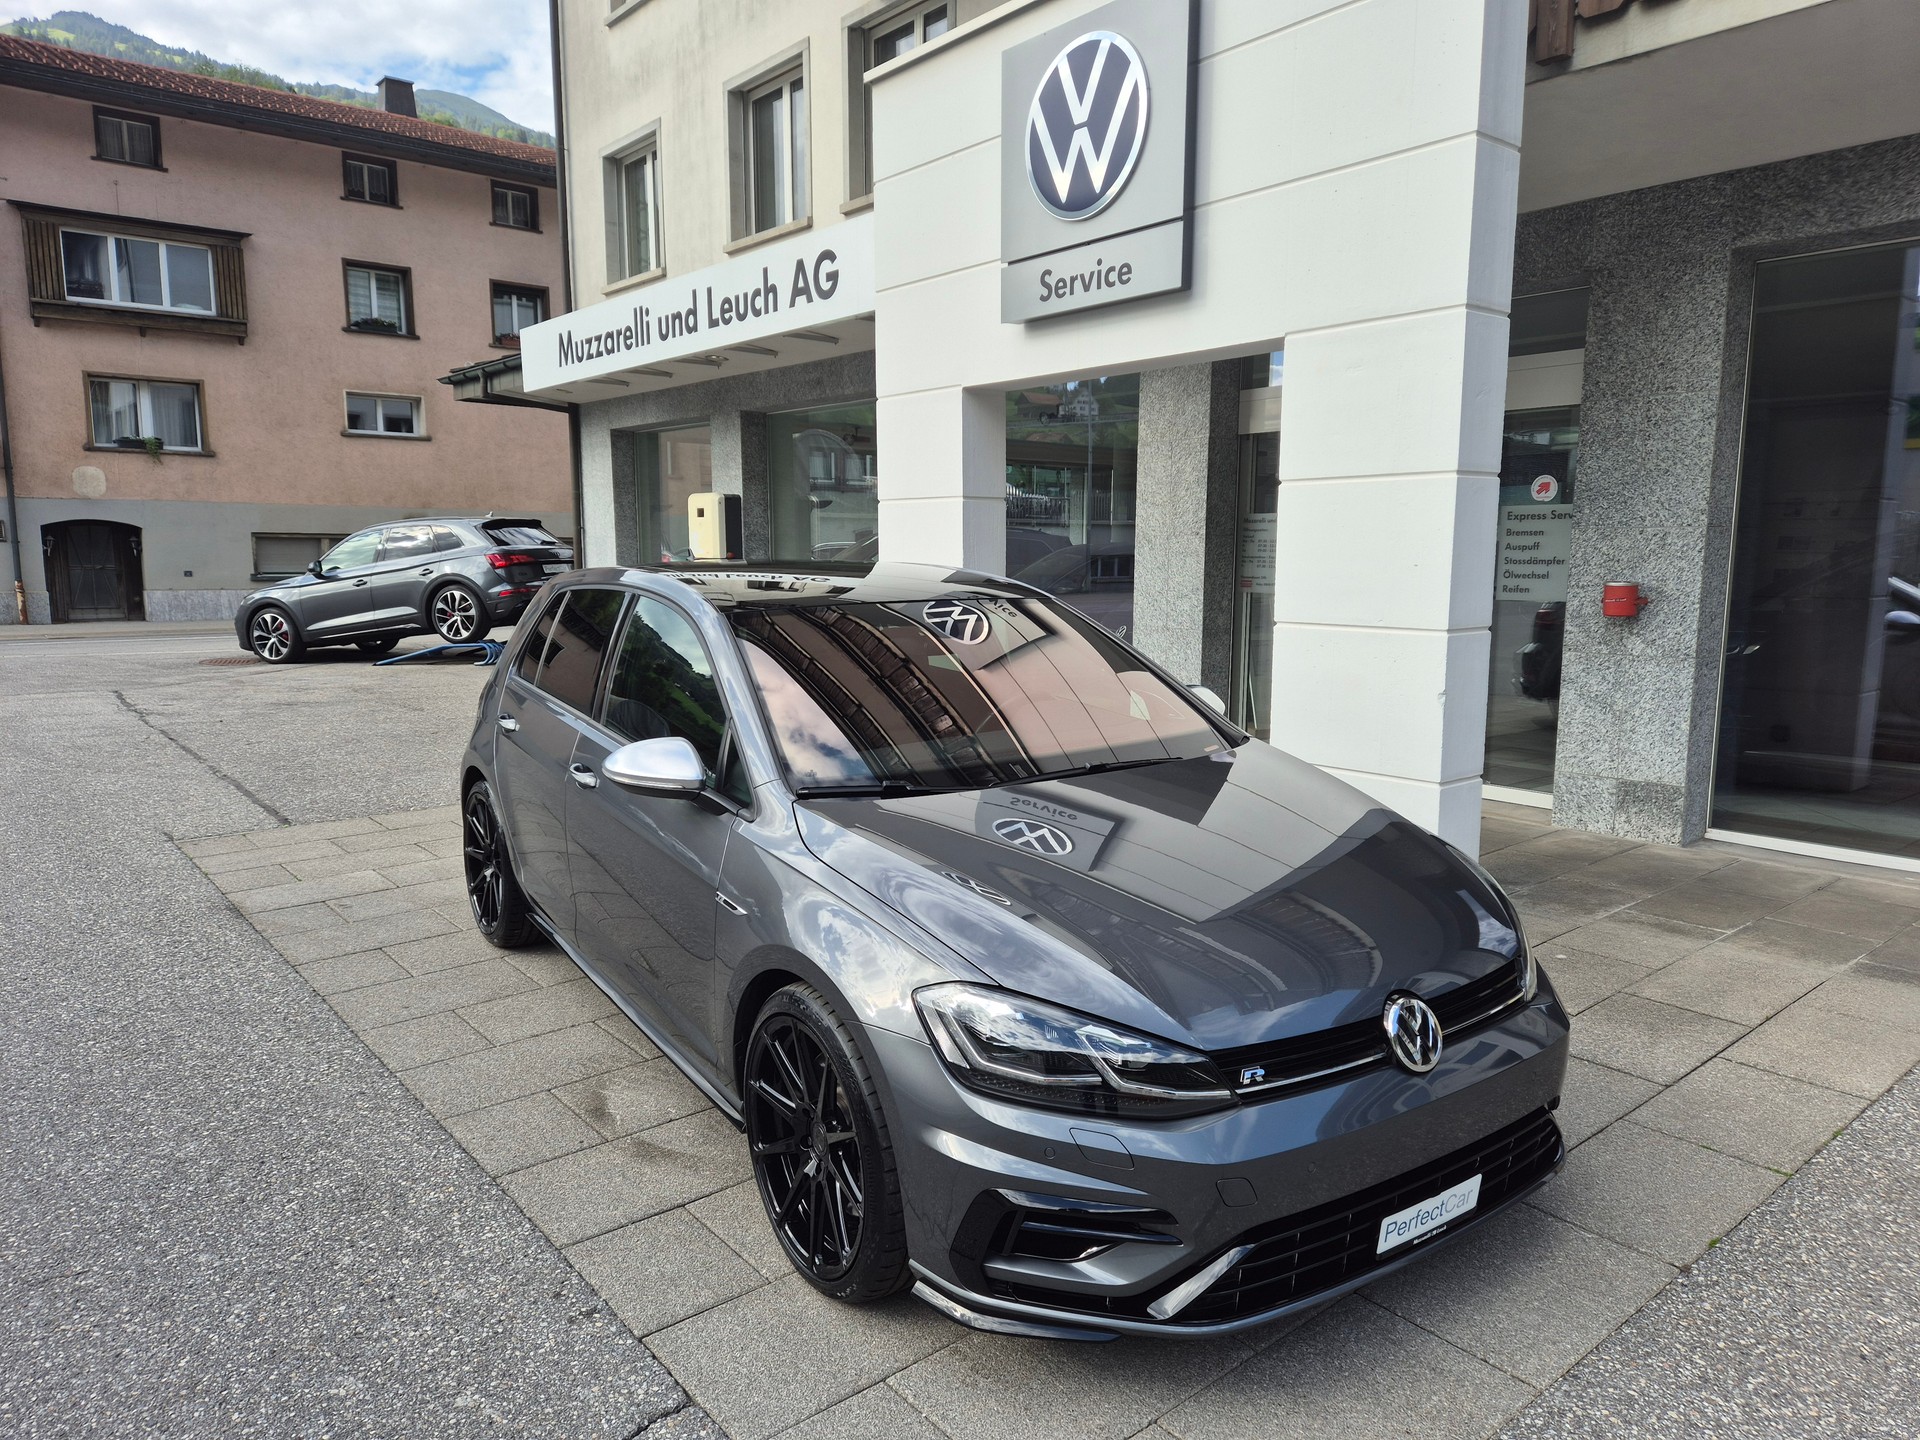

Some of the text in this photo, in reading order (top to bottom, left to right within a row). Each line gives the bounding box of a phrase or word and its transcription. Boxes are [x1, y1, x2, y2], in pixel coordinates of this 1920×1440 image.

[1028, 33, 1144, 212] VW
[1039, 257, 1133, 302] Service
[558, 248, 839, 367] Muzzarelli und Leuch AG
[1507, 511, 1547, 523] Express
[1506, 528, 1544, 537] Bremsen
[1504, 541, 1540, 552] Auspuff
[1503, 556, 1566, 567] Stossdämpfer
[1503, 569, 1550, 580] Ölwechsel
[1502, 584, 1530, 594] Reifen
[1240, 1066, 1265, 1085] R
[1383, 1188, 1475, 1243] PerfectCar
